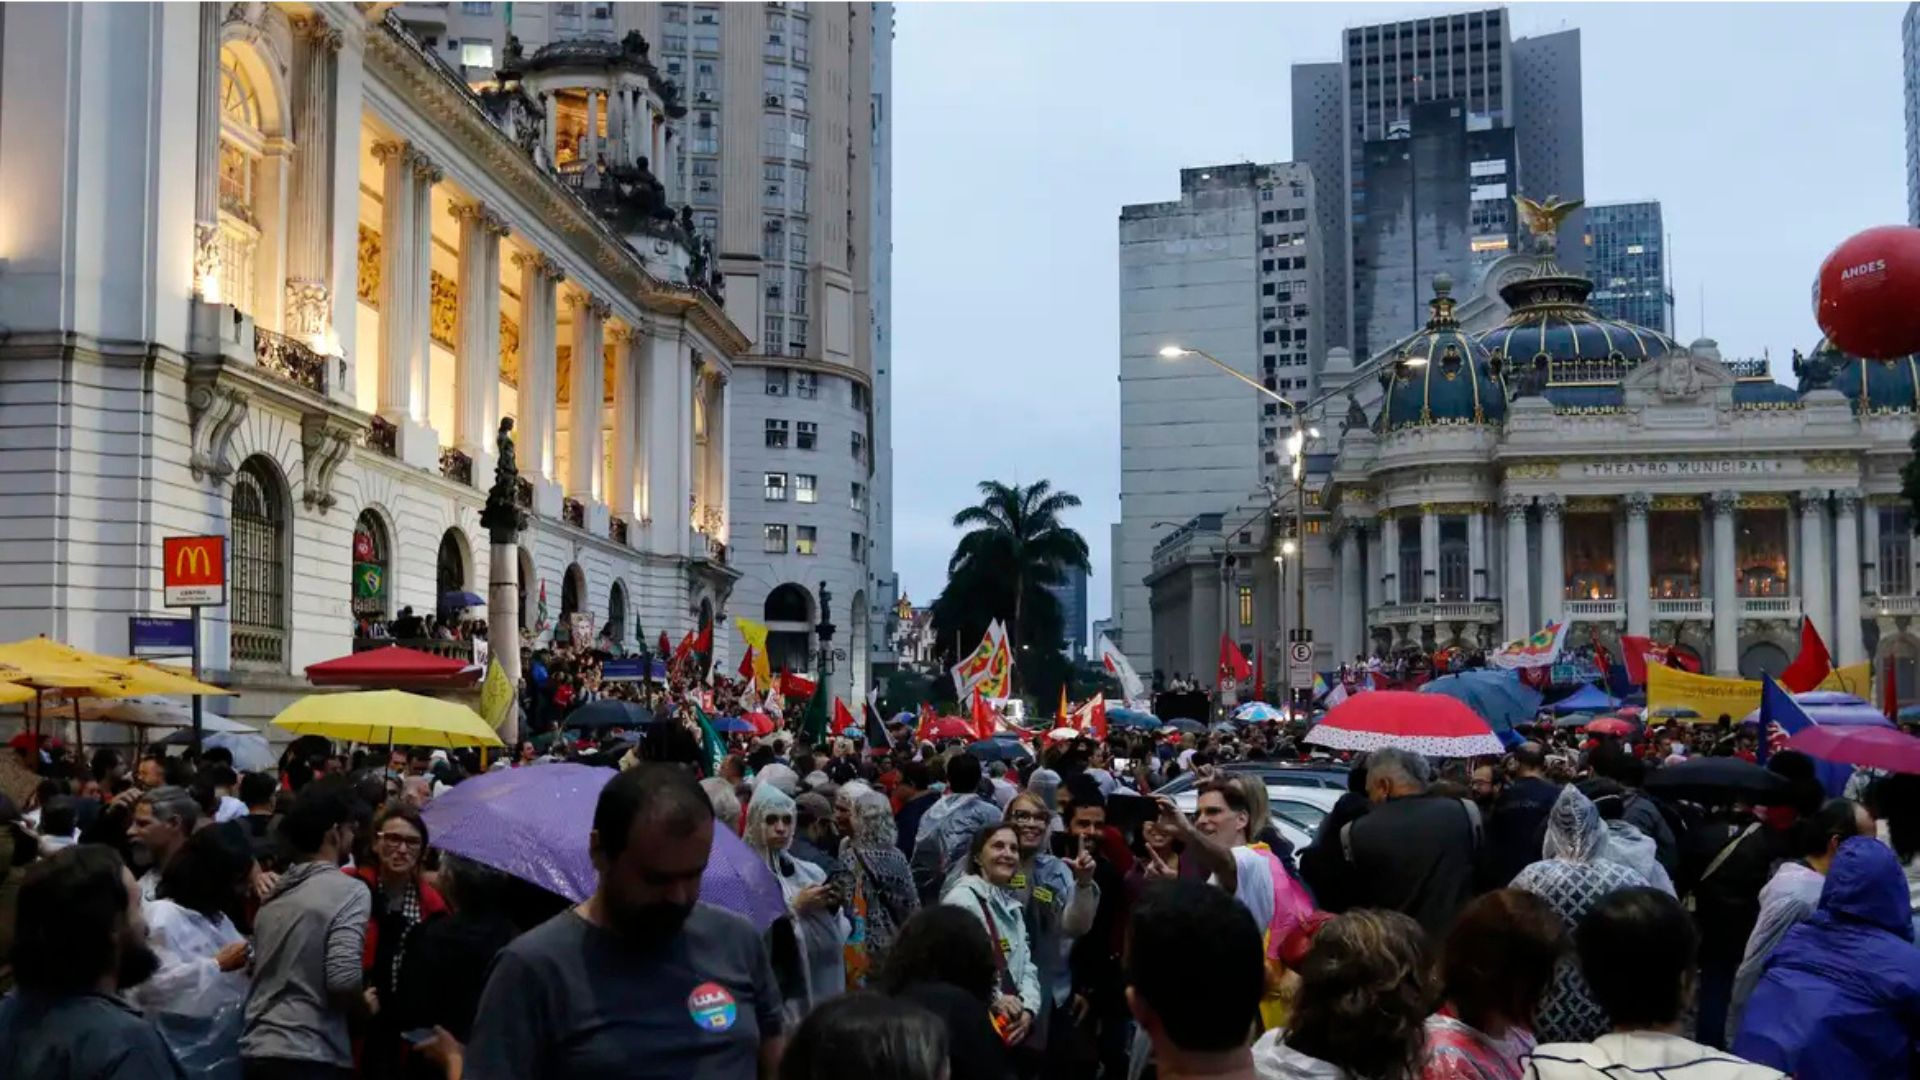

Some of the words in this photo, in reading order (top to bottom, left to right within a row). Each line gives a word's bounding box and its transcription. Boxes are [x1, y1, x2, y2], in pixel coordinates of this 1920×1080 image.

[1841, 259, 1885, 280] ANDES
[1593, 463, 1669, 475] THEATRO
[1677, 460, 1770, 474] MUNICIPAL
[1297, 646, 1306, 658] E
[693, 991, 727, 1006] LULA
